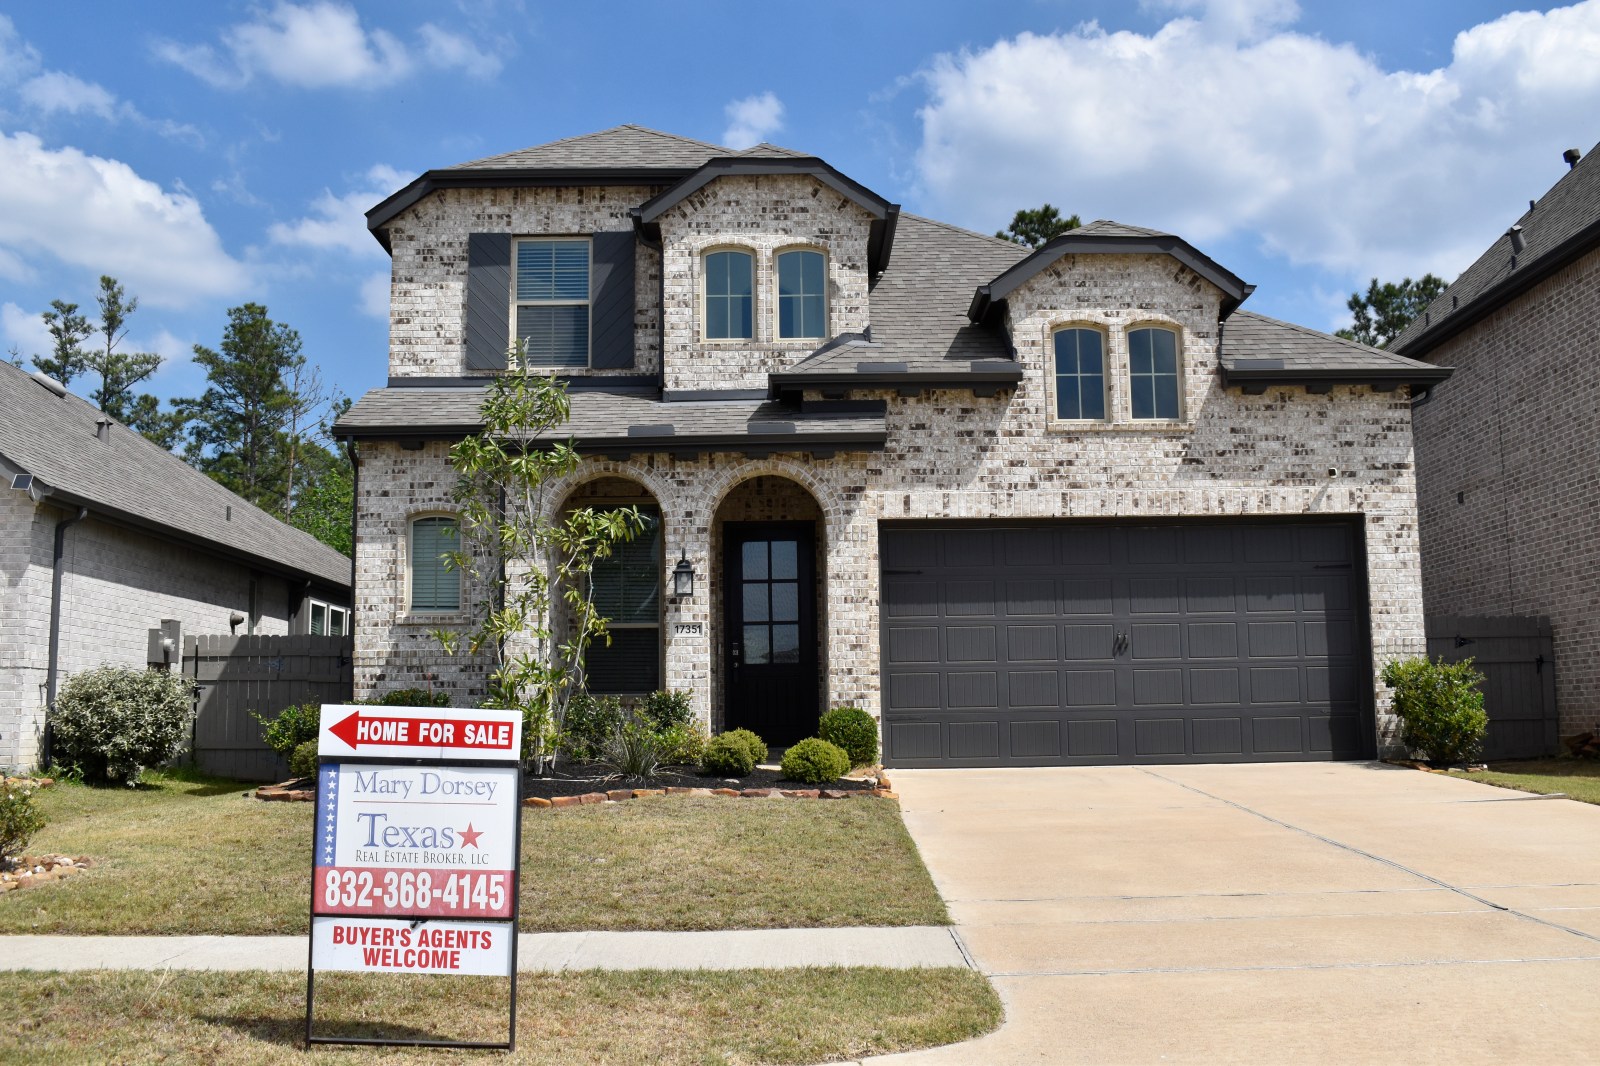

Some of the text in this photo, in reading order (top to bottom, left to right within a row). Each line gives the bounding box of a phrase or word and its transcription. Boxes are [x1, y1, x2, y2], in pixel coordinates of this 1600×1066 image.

[674, 624, 702, 634] 17351
[356, 720, 510, 746] HOME FOR SALE
[353, 770, 498, 801] Mary Dorsey
[357, 812, 454, 849] Texas
[355, 849, 380, 862] REAL
[384, 850, 419, 864] ESTATE
[471, 853, 489, 865] LLC
[325, 869, 505, 910] 832-368-4145
[332, 925, 492, 950] BUYER'S AGENTS
[362, 947, 461, 969] WELCOME
